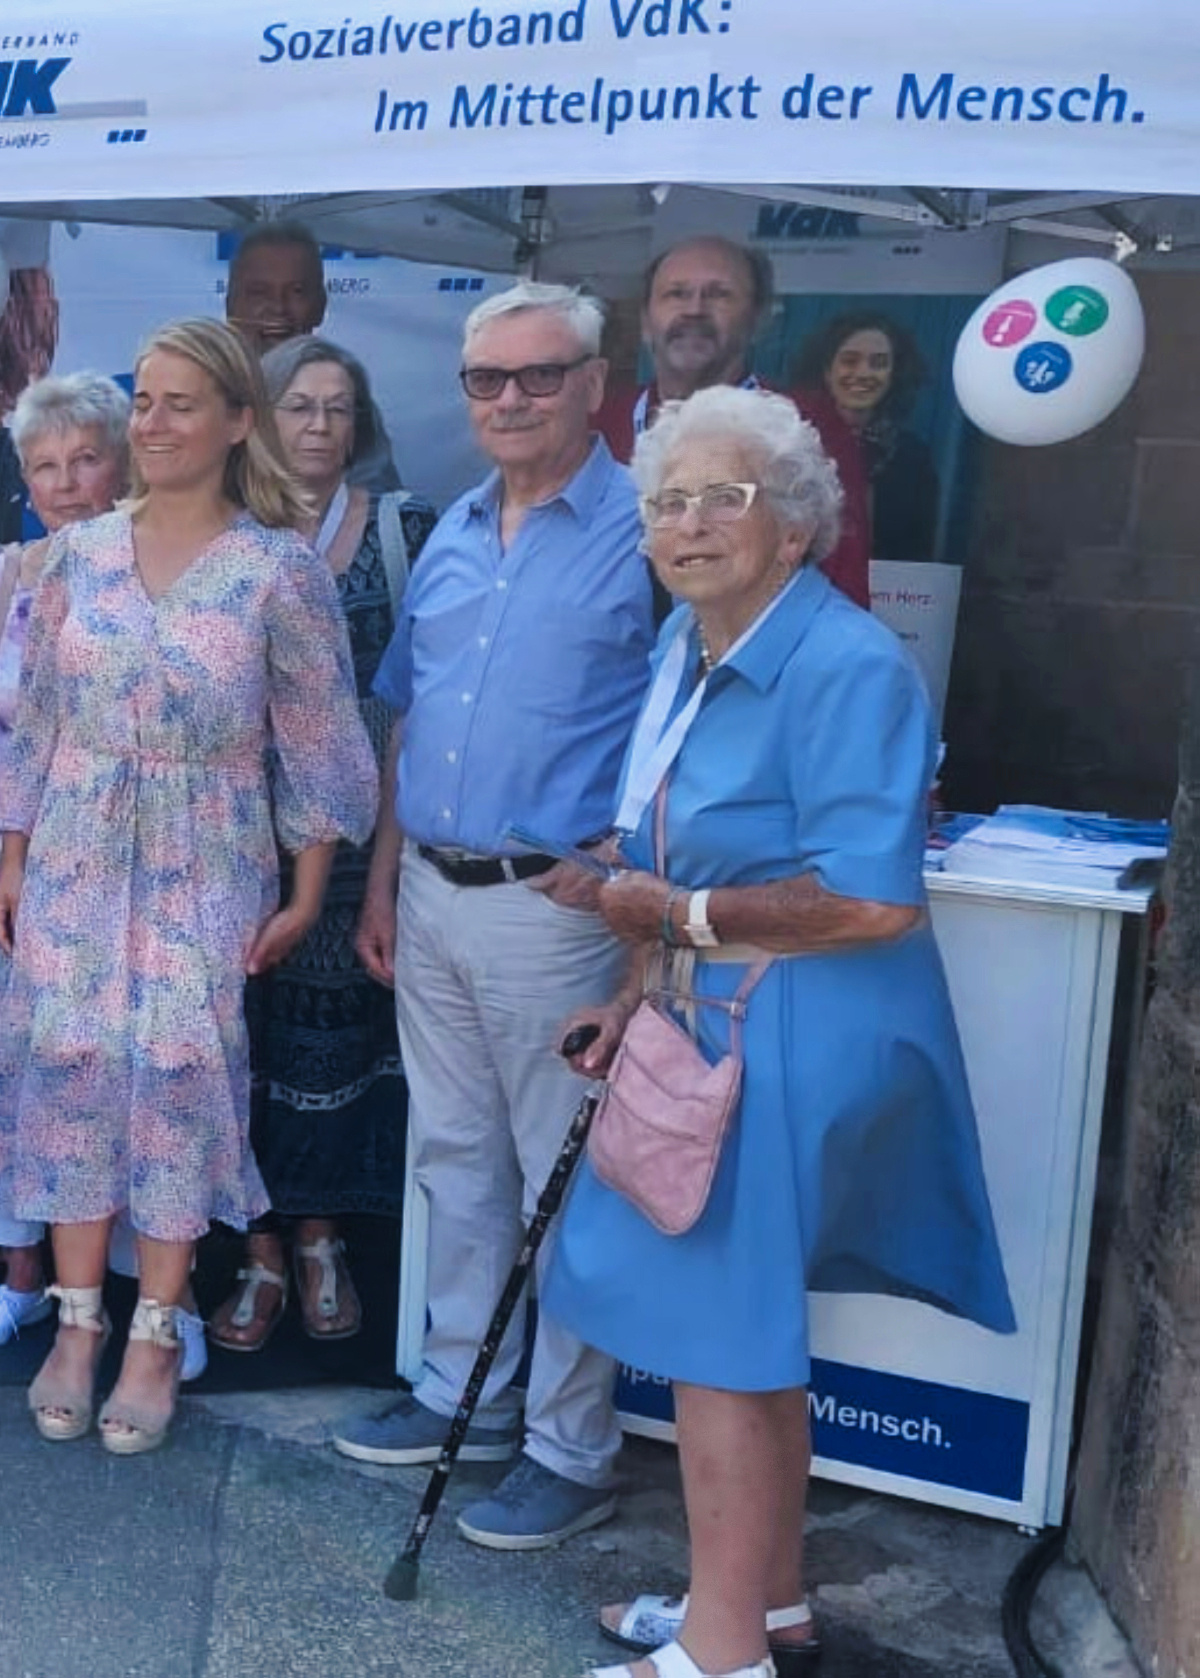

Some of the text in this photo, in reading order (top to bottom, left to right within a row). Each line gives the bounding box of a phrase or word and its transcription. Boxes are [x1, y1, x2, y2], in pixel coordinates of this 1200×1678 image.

[259, 0, 733, 64] Sozialverband VdK:
[374, 72, 1146, 135] Im Mittelpunkt der Mensch.
[807, 1392, 952, 1449] Mensch.
